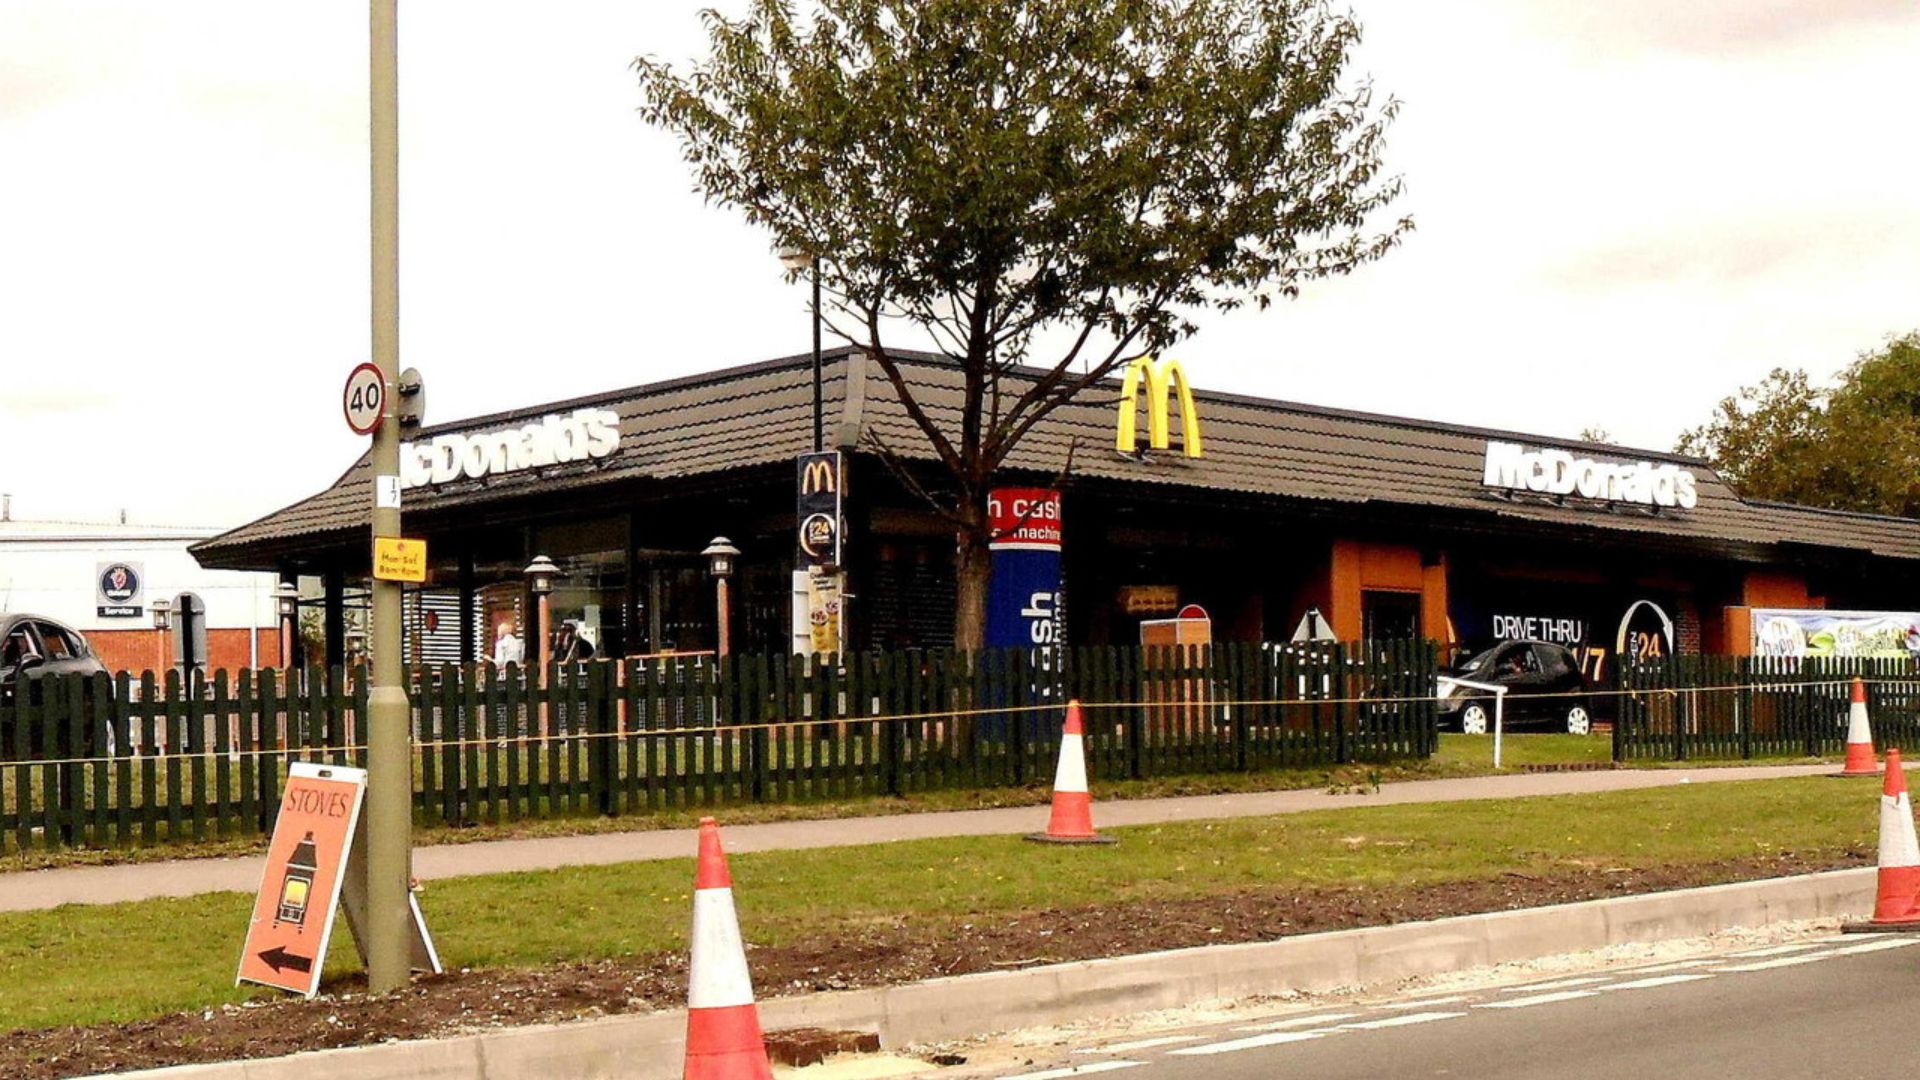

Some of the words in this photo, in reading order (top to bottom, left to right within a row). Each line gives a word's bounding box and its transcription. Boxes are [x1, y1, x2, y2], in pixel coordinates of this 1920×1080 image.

[350, 383, 379, 413] 40
[400, 407, 620, 490] cDonald's
[1483, 440, 1698, 509] McDonald's
[1493, 615, 1537, 640] DRIVE
[1540, 617, 1583, 643] THRU
[1638, 632, 1661, 663] 24
[287, 787, 349, 818] STOVES
